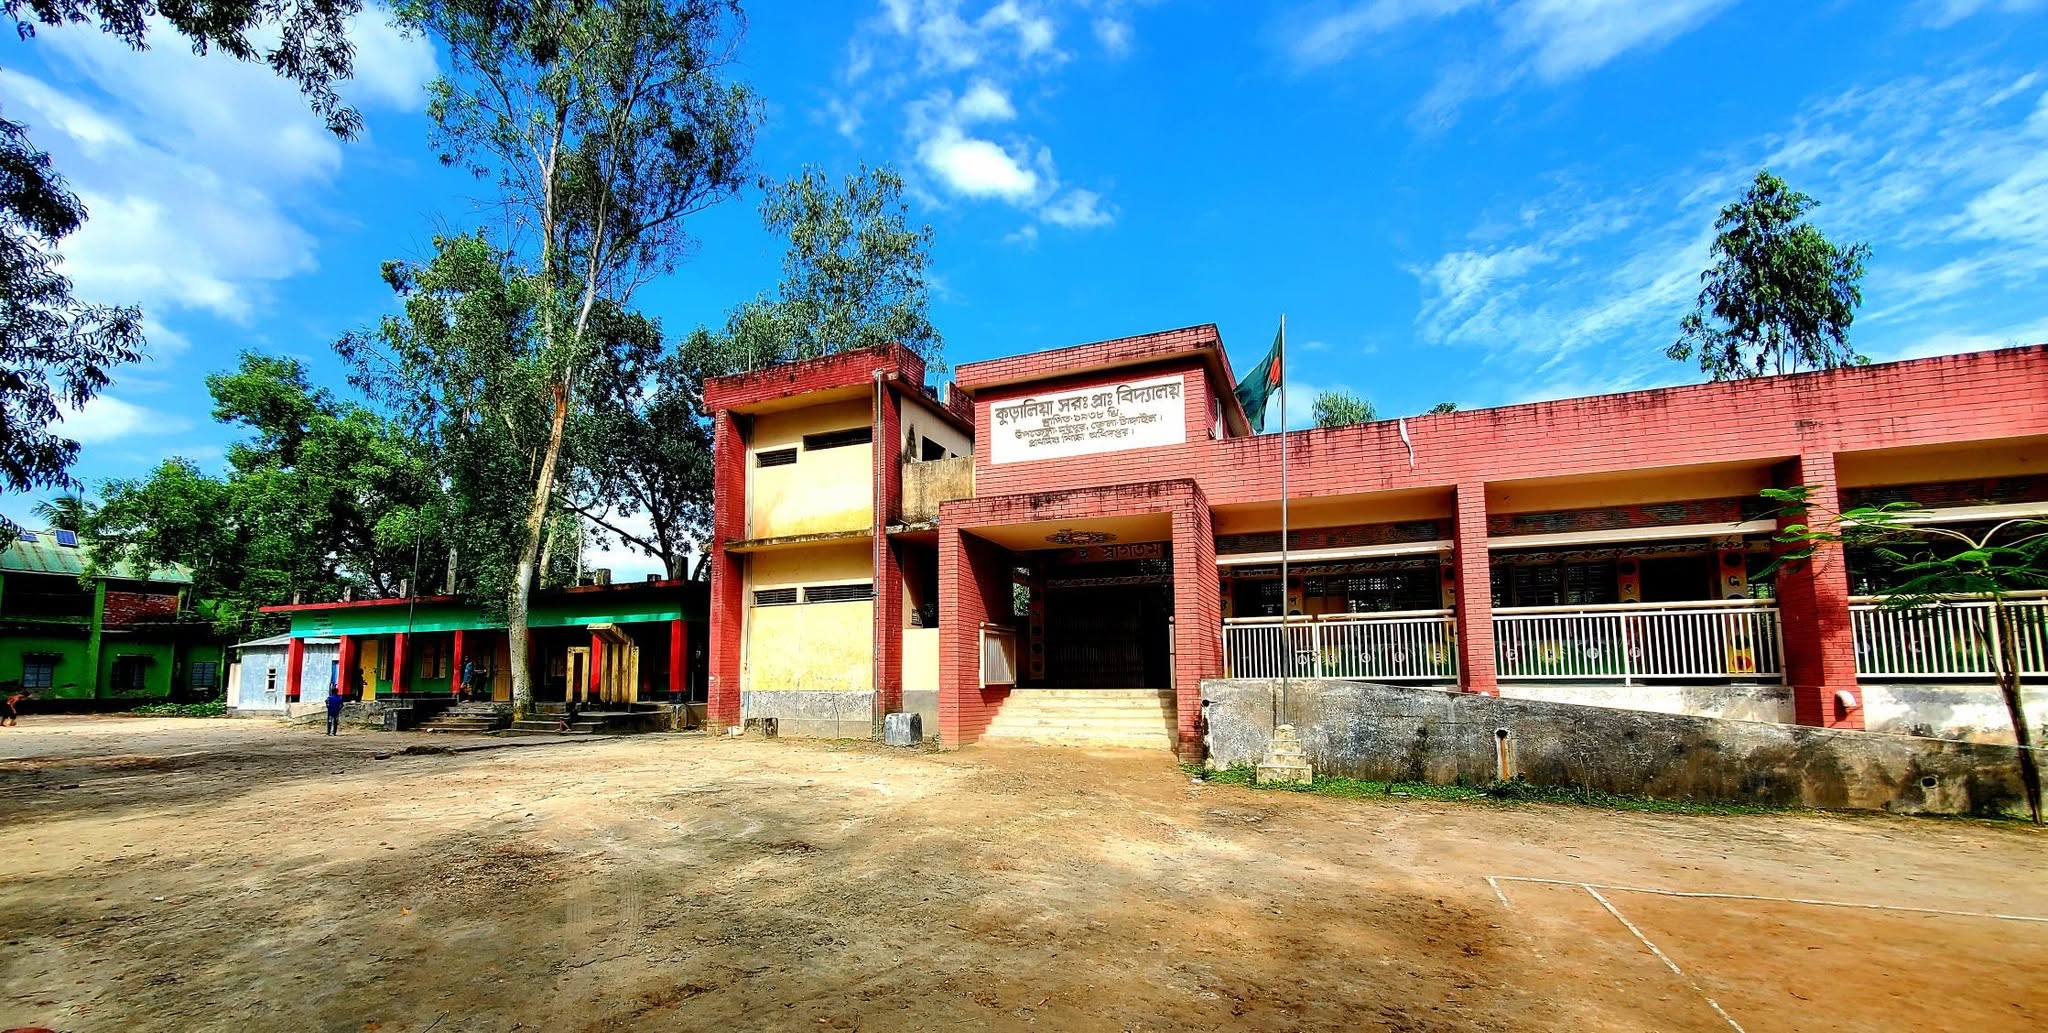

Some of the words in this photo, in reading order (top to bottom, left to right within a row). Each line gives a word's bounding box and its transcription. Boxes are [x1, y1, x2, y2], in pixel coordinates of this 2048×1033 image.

[995, 398, 1055, 426] কুড়ালিয়া
[1057, 396, 1089, 413] সরঃ
[1091, 392, 1113, 409] প্রাঃ
[1116, 382, 1182, 405] বিদ্যালয়
